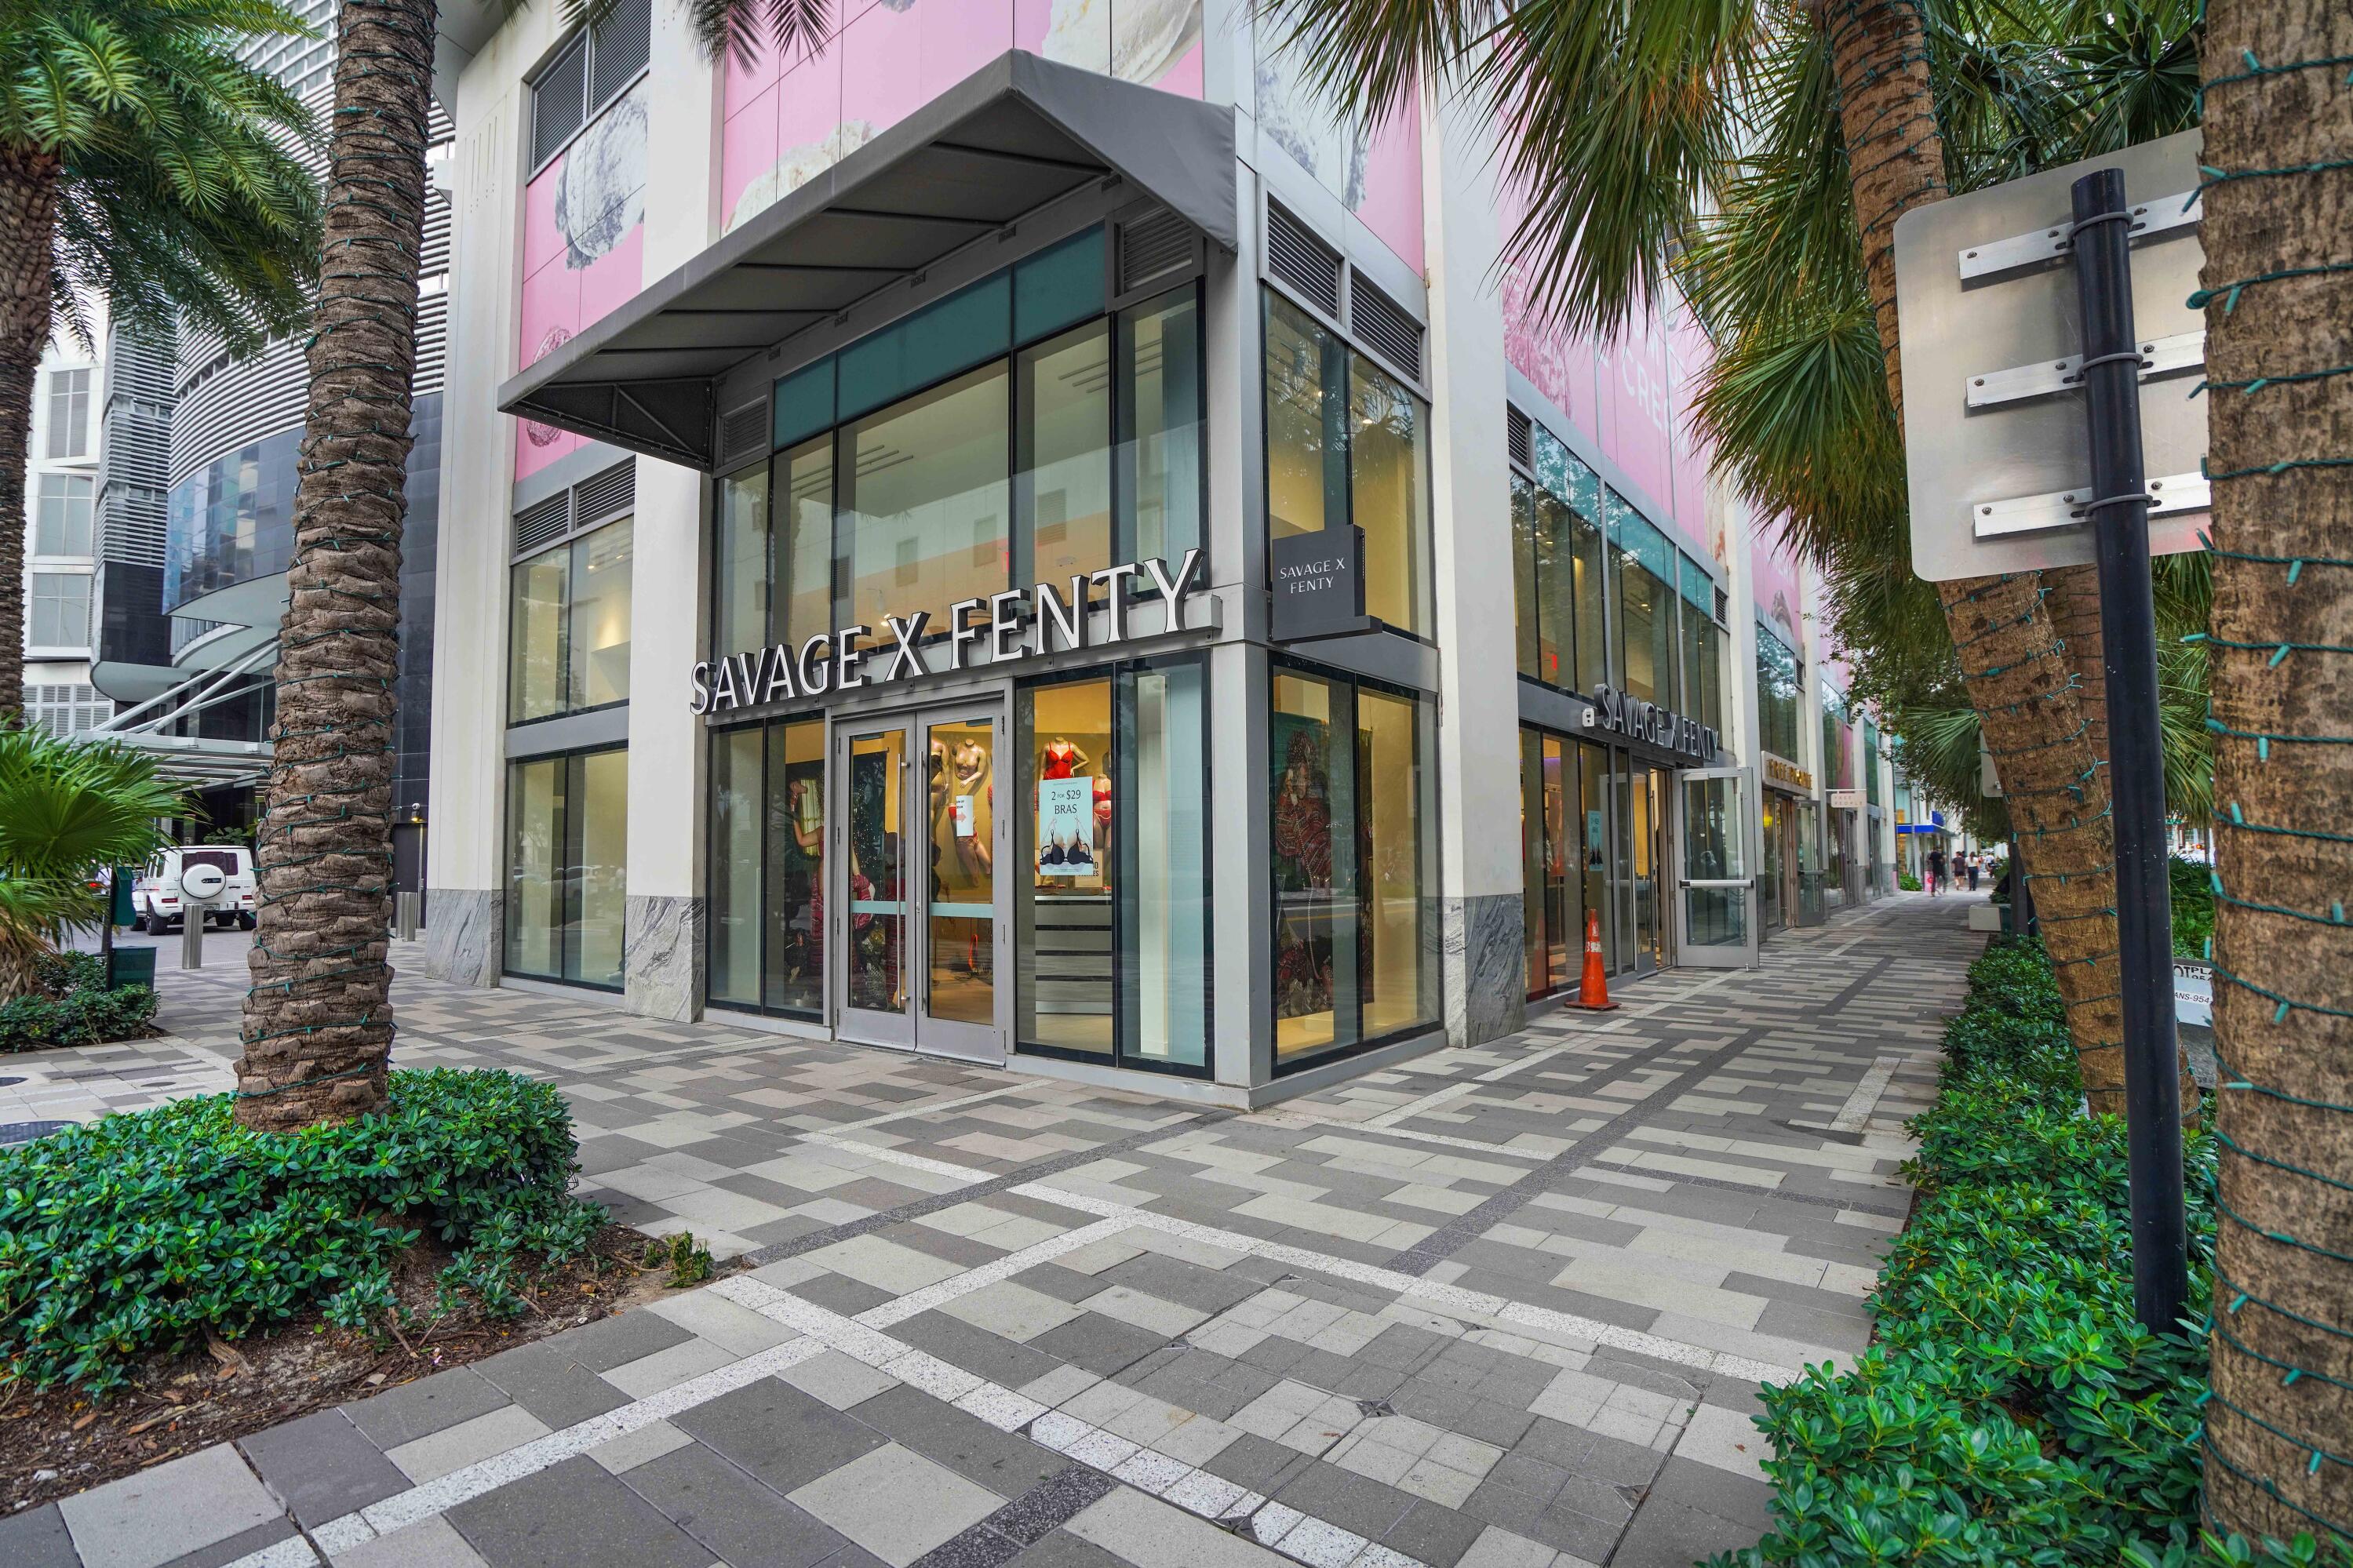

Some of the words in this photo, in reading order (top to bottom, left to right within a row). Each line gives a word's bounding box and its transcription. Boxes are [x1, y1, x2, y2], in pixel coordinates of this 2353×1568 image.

[1280, 560, 1331, 580] SAVAGE
[1335, 558, 1346, 569] X
[1290, 577, 1335, 594] FENTY
[690, 625, 872, 715] SAVAGE
[884, 611, 931, 682] X
[950, 548, 1206, 670] FENTY
[1594, 683, 1666, 747] SAVAGE
[1665, 711, 1679, 751] X
[1679, 716, 1719, 762] FENTY
[1051, 791, 1056, 800] 2
[1066, 789, 1081, 800] $29
[1054, 804, 1077, 814] BRAS
